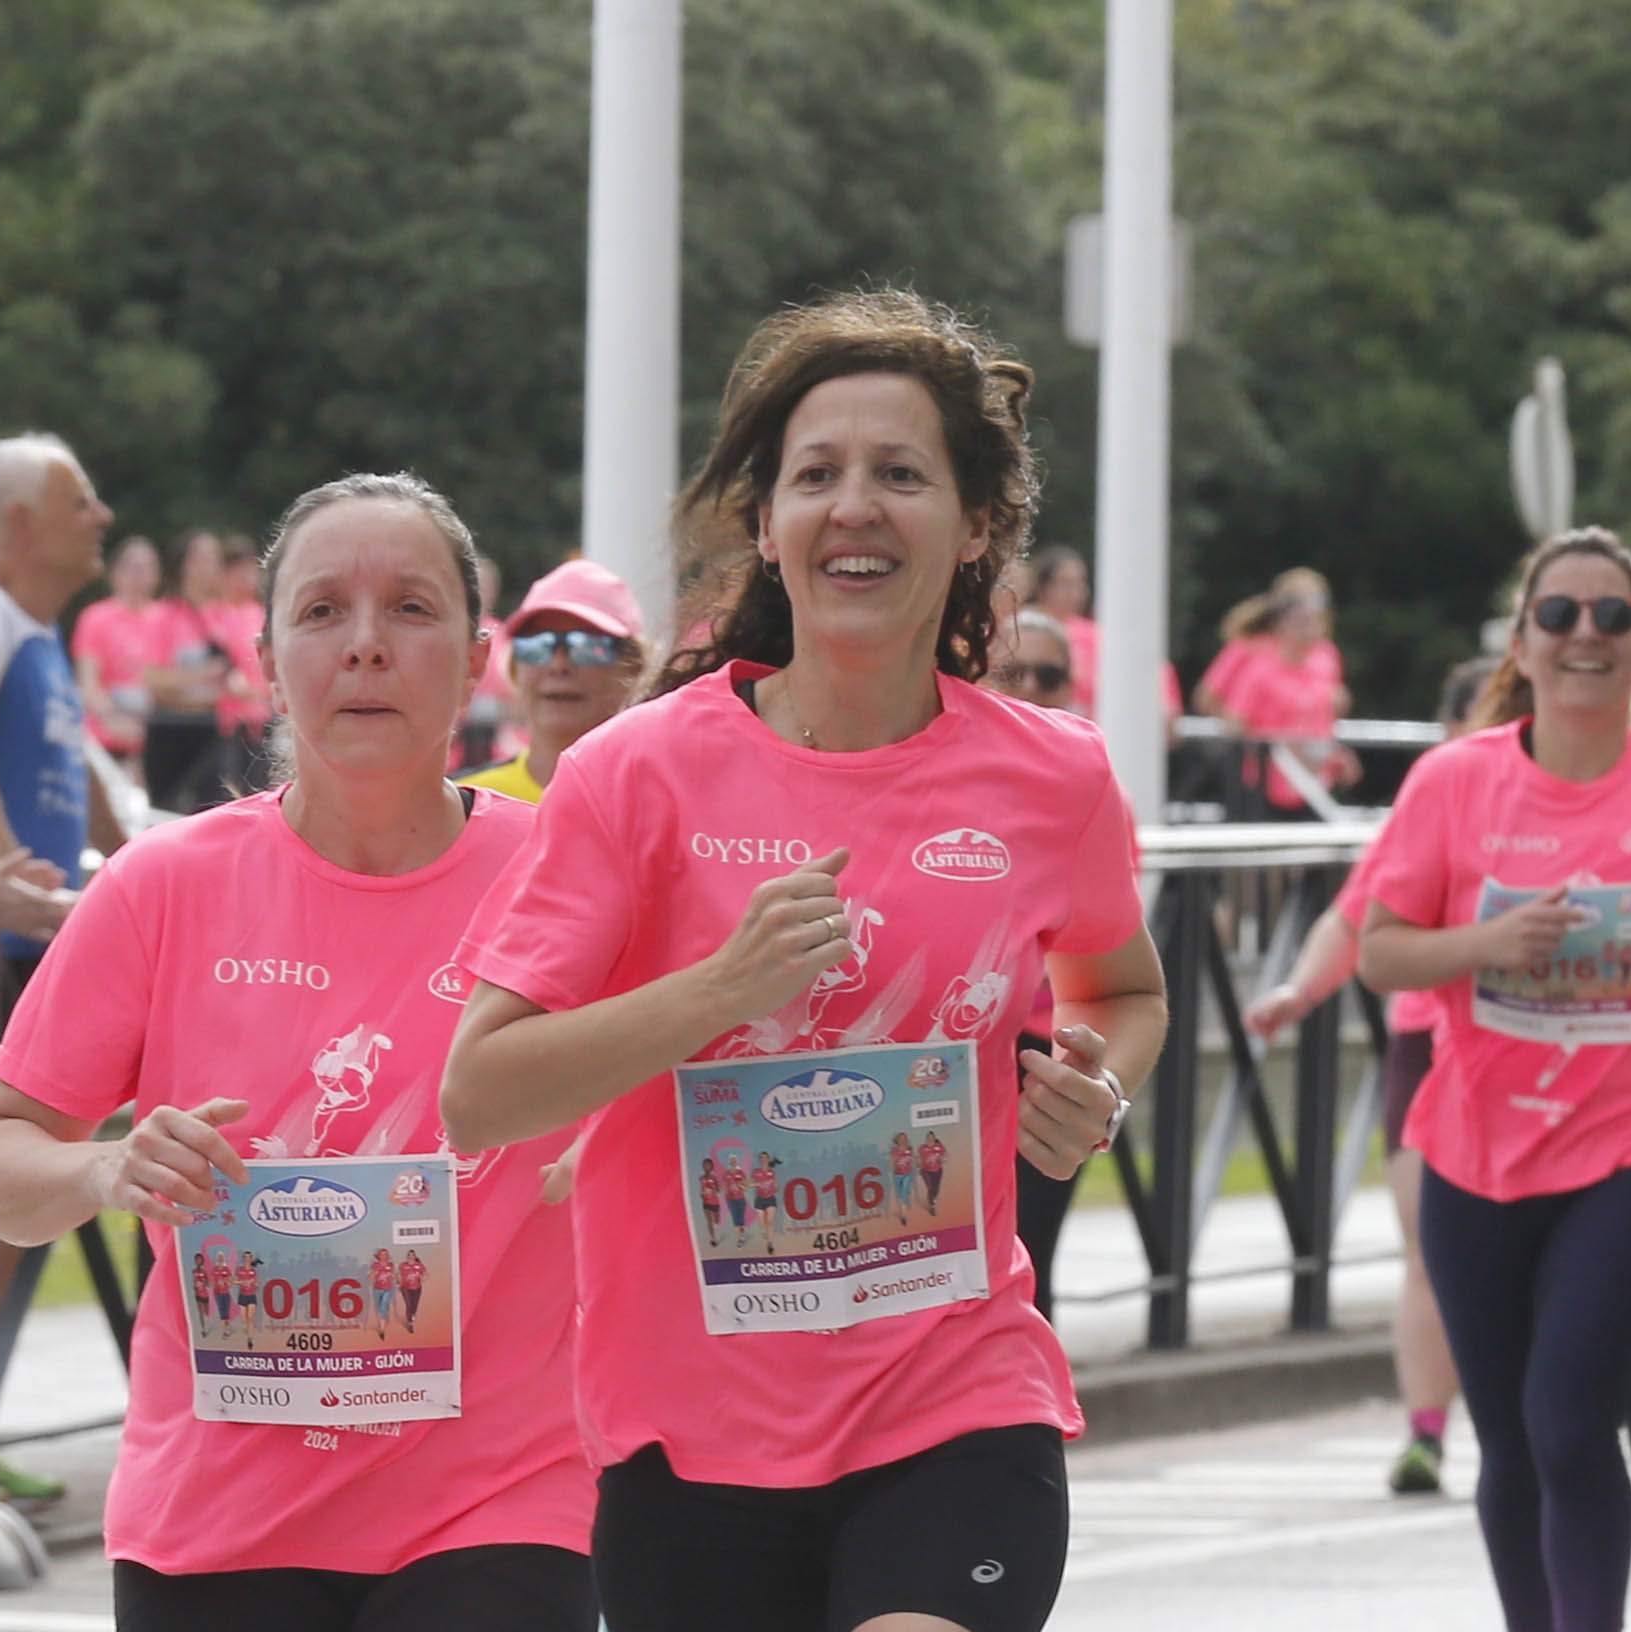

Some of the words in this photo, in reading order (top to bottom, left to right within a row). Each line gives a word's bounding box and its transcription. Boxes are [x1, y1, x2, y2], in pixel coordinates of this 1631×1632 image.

[692, 832, 811, 865] OYSHO
[919, 849, 1008, 871] ASTURIANA
[214, 957, 330, 991] OYSHO
[769, 1092, 876, 1120] ASTURIANA
[783, 1166, 885, 1221] 016
[257, 1200, 358, 1221] ASTURIANA
[813, 1228, 860, 1251] 4604
[740, 1260, 801, 1278] CARRERA
[804, 1258, 824, 1274] DE
[826, 1257, 846, 1272] LA
[847, 1246, 889, 1269] MUJER
[263, 1278, 364, 1319] 016
[734, 1291, 820, 1315] OYSHO
[870, 1270, 954, 1300] Santander
[286, 1333, 333, 1351] 4609
[224, 1355, 275, 1371] CARRERA
[279, 1356, 295, 1371] DE
[297, 1357, 313, 1372] LA
[317, 1357, 363, 1371] MUJER
[375, 1350, 415, 1369] GIJÓN
[220, 1384, 291, 1407] OYSHO
[342, 1387, 427, 1408] Santander
[303, 1429, 339, 1451] 2024
